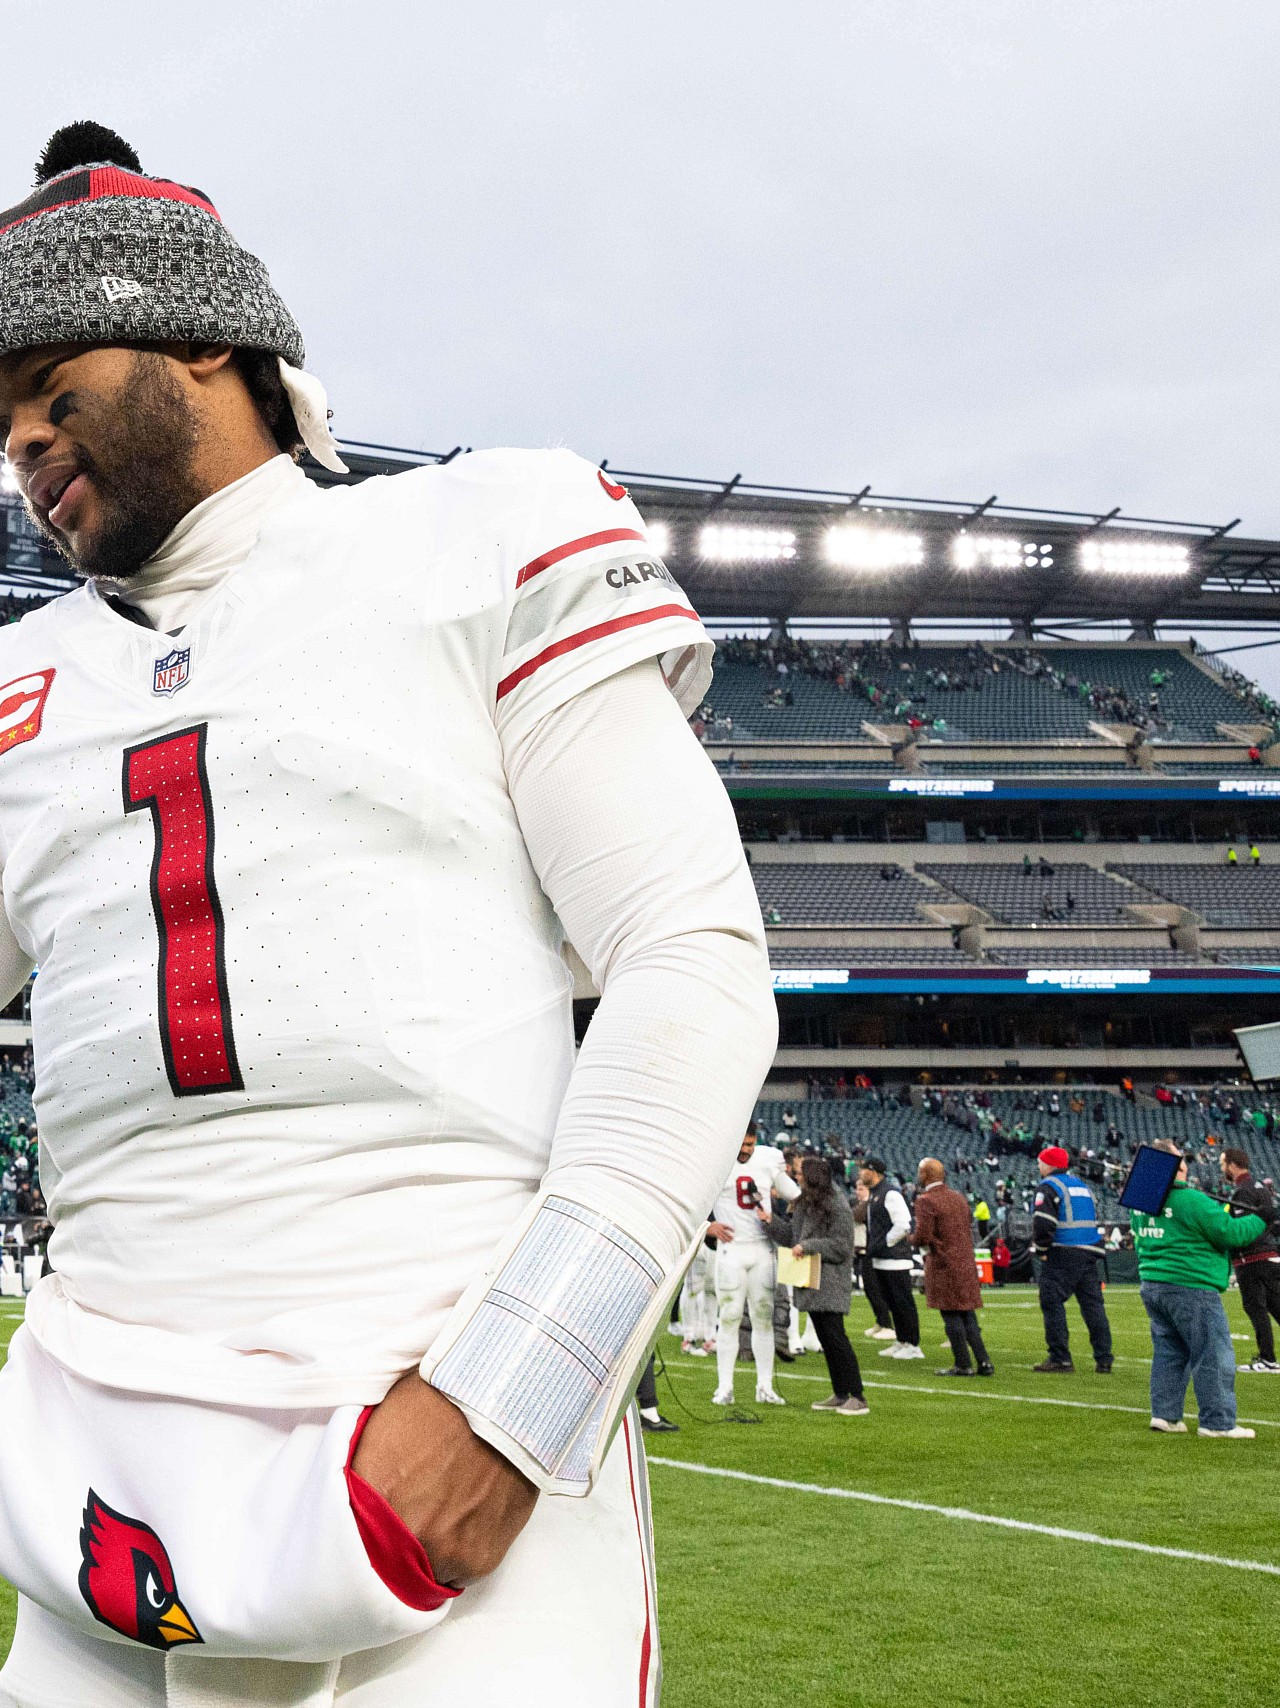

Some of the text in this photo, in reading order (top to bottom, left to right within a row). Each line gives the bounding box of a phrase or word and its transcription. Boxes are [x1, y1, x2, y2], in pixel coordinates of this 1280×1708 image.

[157, 665, 185, 688] NFL
[122, 721, 246, 1097] 1
[736, 1175, 756, 1210] 8
